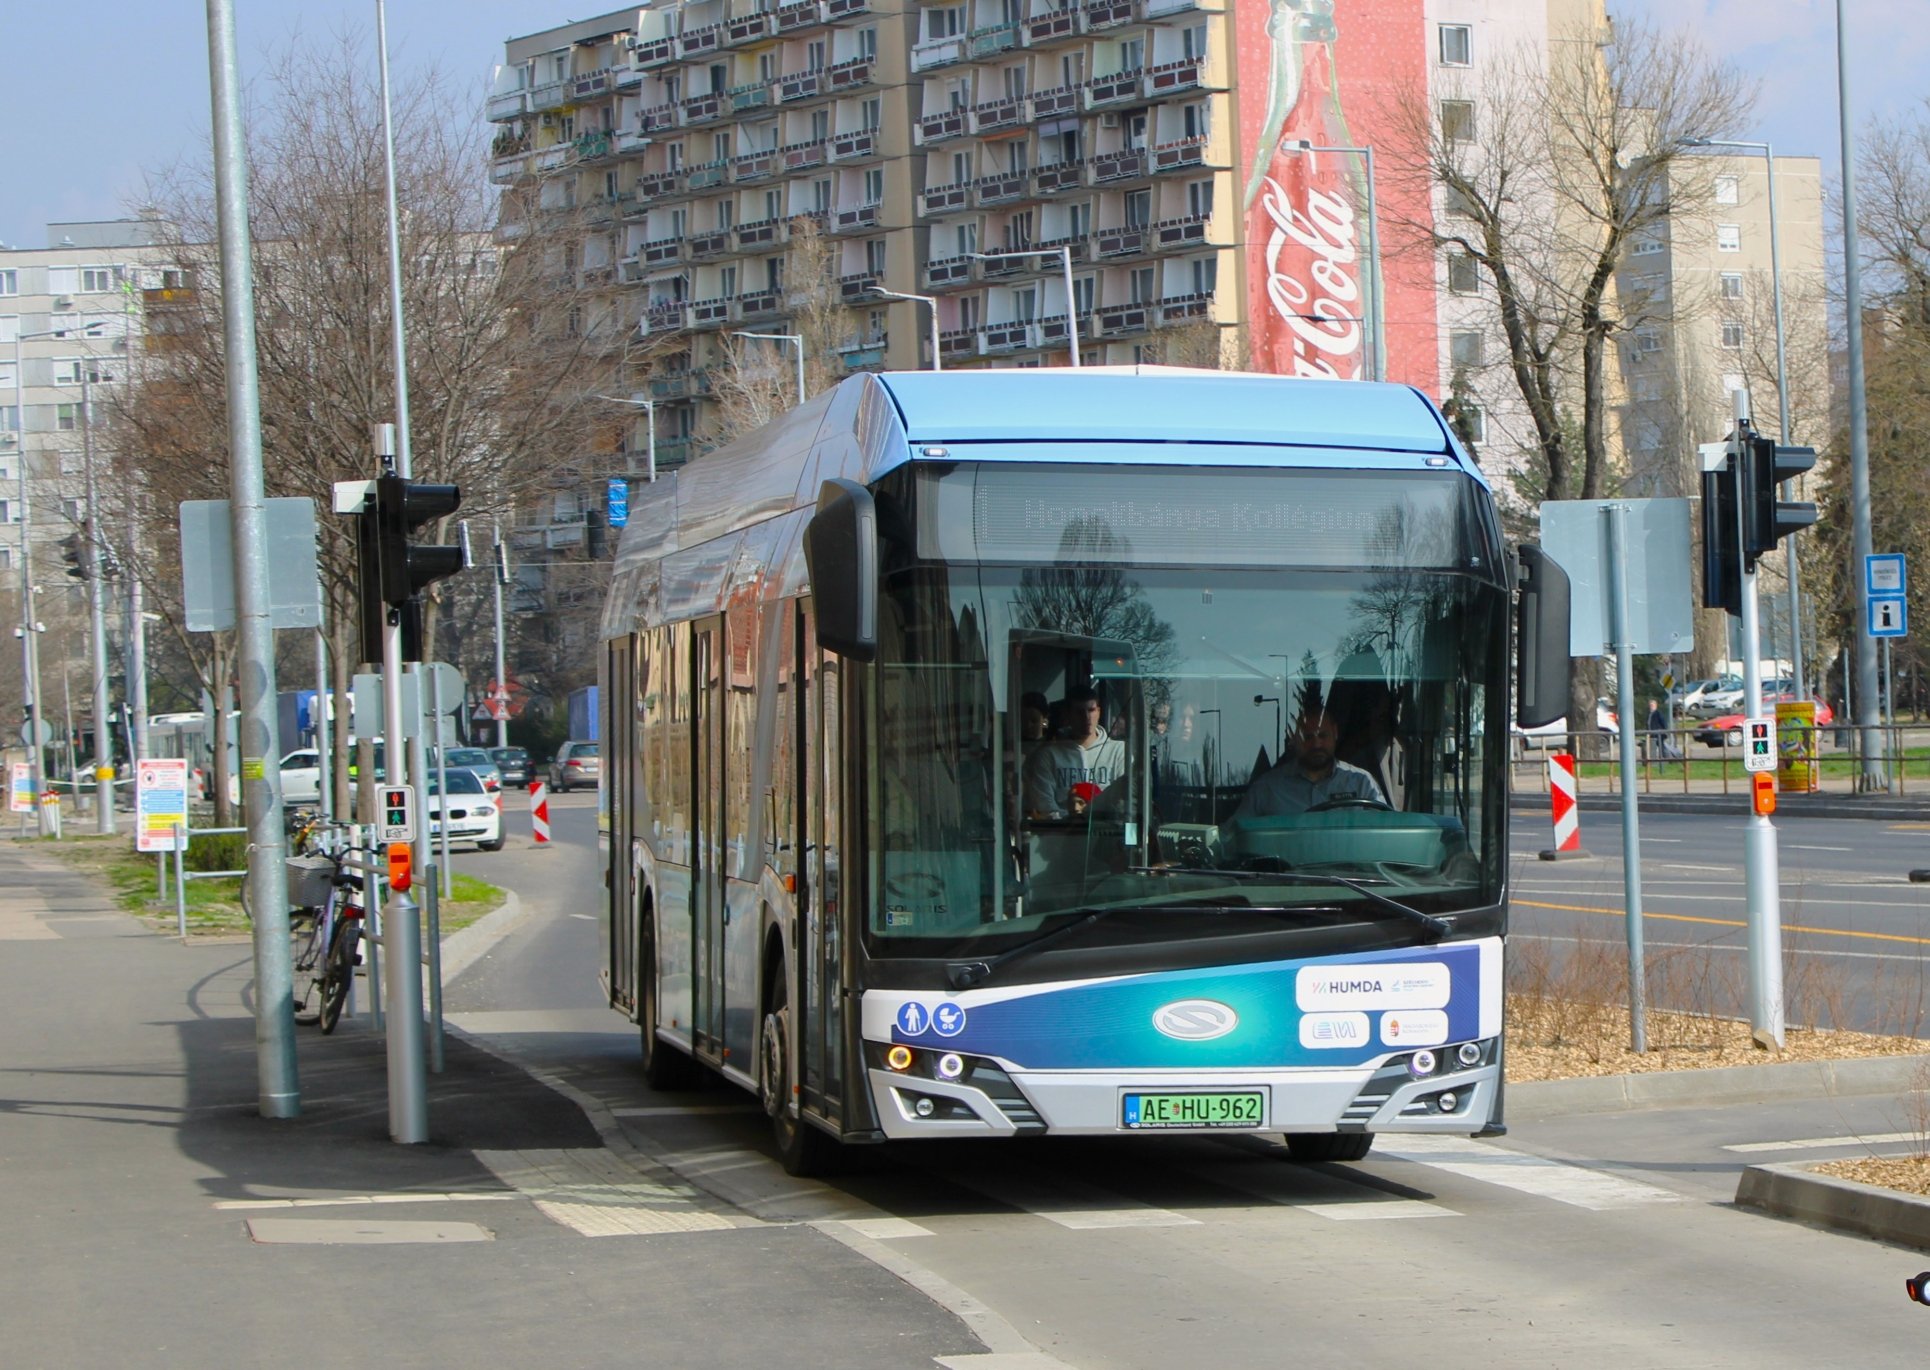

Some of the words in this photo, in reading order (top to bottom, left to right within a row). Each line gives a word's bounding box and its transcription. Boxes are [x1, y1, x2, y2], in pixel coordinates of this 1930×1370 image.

[1232, 503, 1375, 533] Kollégium
[1329, 980, 1383, 994] HUMDA
[1129, 1111, 1137, 1120] H
[1143, 1099, 1170, 1120] AE
[1182, 1097, 1257, 1120] HU-962
